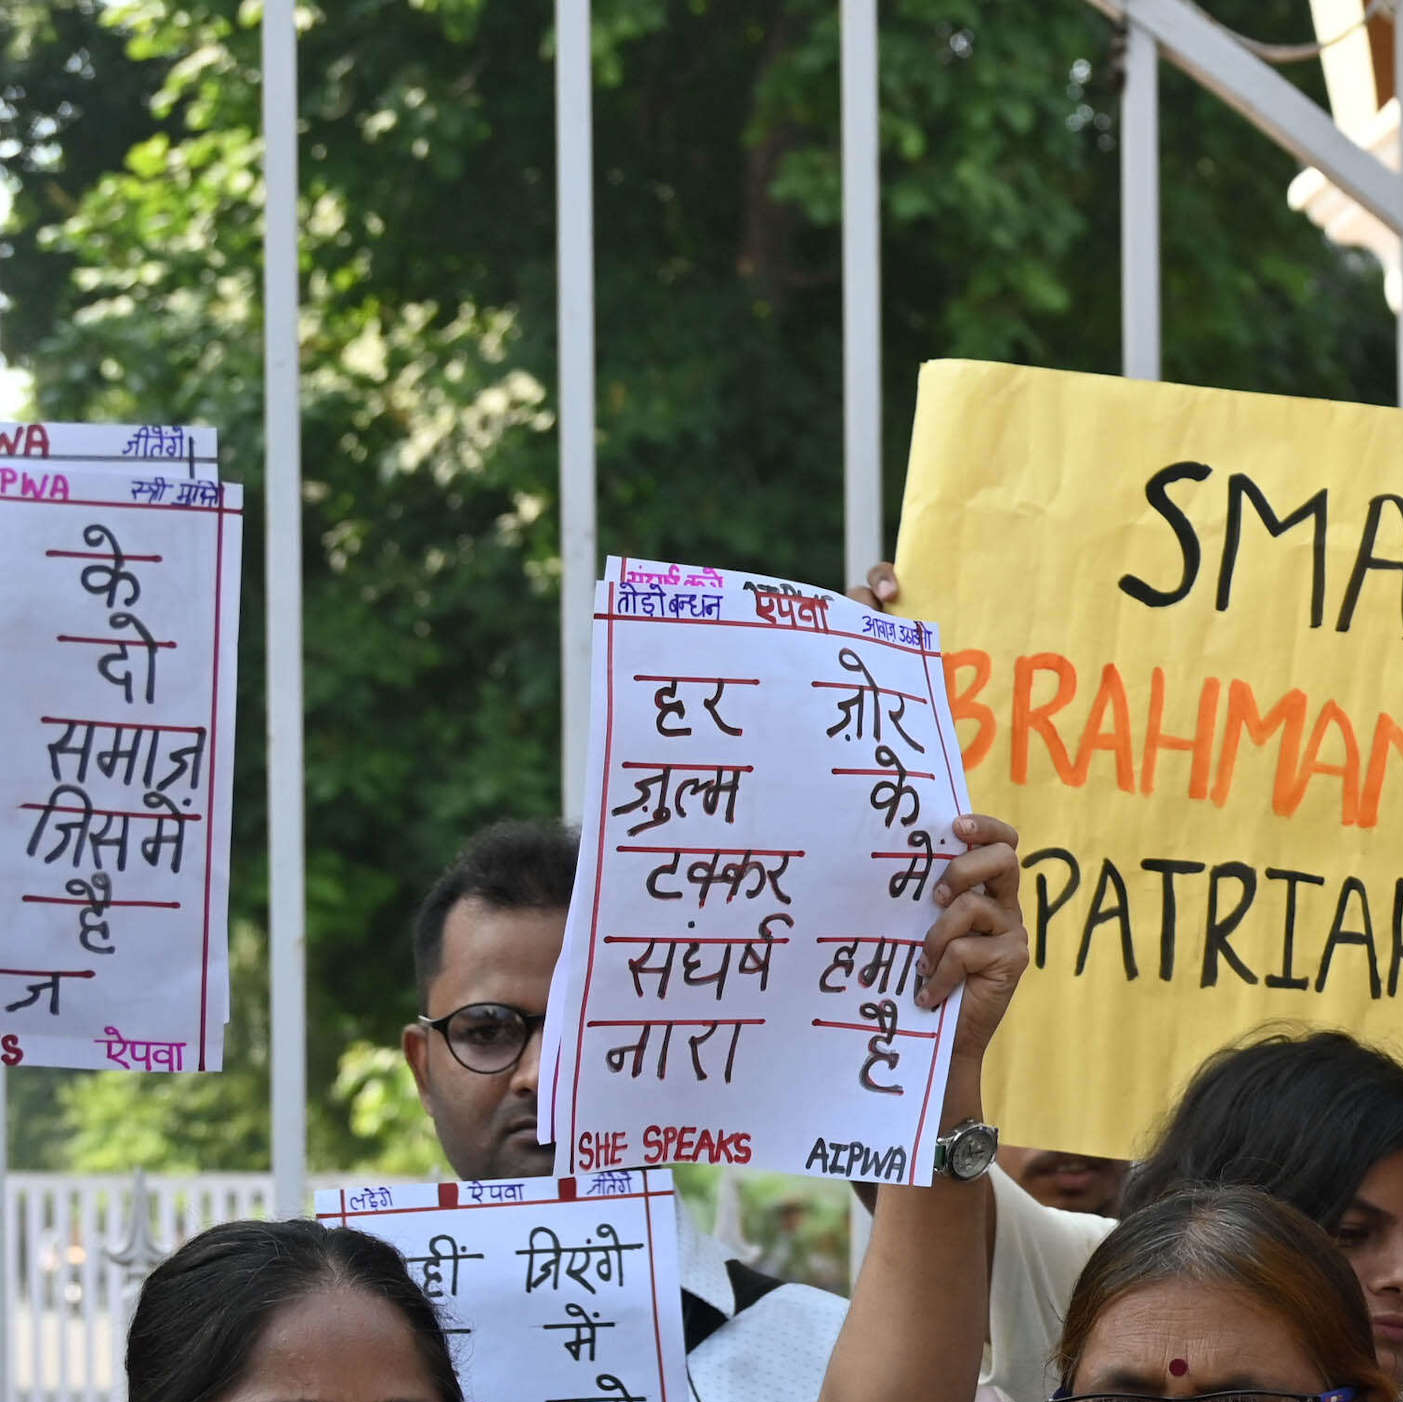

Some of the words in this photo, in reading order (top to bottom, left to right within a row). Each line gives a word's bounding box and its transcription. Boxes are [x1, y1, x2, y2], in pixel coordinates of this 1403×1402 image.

[46, 524, 162, 607] के
[57, 611, 177, 703] दो
[633, 674, 760, 737] हर
[41, 716, 206, 789] समाज
[831, 745, 936, 829] के
[18, 784, 202, 874] जिसमें
[616, 846, 806, 908] टक्कर
[604, 913, 795, 1001] संघर्ष
[587, 1018, 766, 1084] नारा
[811, 999, 938, 1097] है
[579, 1131, 628, 1172] SHE
[643, 1125, 753, 1165] SPEAKS
[805, 1136, 907, 1183] AIPWA
[542, 1303, 615, 1361] में
